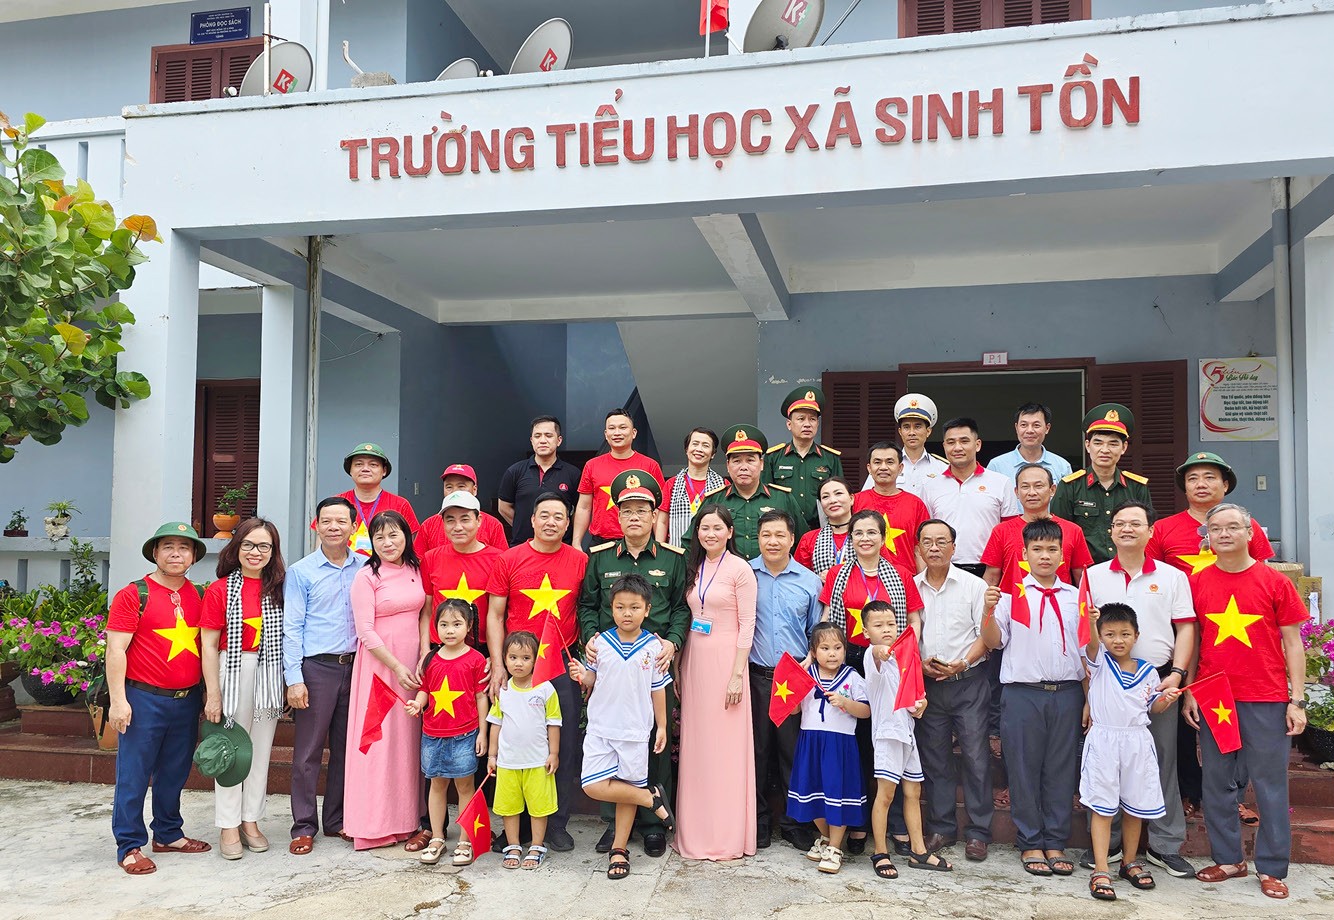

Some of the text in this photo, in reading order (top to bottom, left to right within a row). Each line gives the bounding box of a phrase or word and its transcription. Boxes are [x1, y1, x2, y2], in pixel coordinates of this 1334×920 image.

[228, 18, 241, 26] SÁCH
[340, 52, 1140, 180] TRƯỜNG TIỂU HỌC XÃ SINH TỒN
